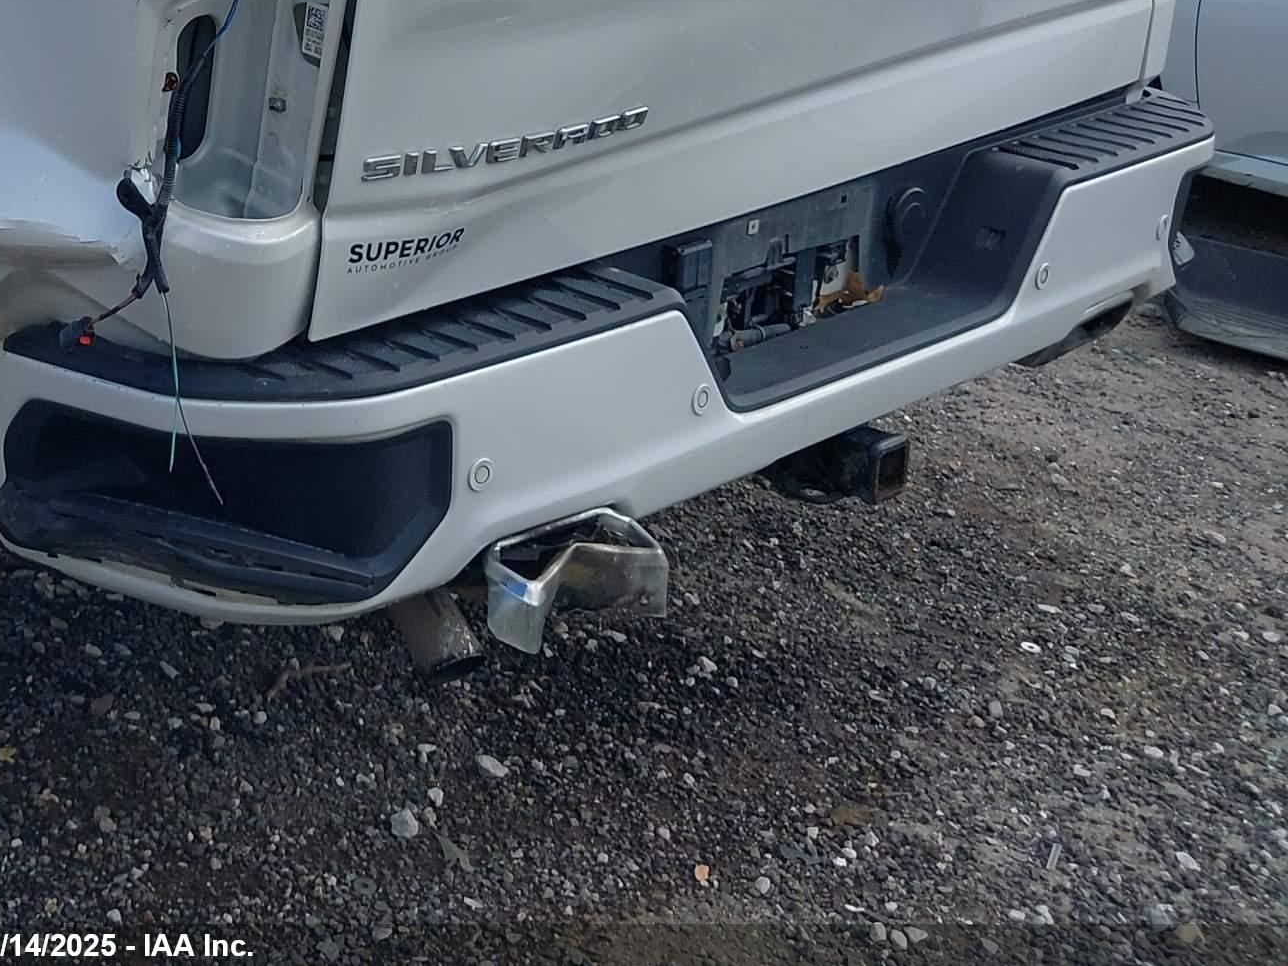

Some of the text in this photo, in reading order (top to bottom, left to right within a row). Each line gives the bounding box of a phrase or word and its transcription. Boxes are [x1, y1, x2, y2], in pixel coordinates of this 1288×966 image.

[361, 105, 649, 182] SILVERADO
[348, 228, 465, 263] SUPERIOR
[346, 257, 420, 274] AUTOMOTIVE
